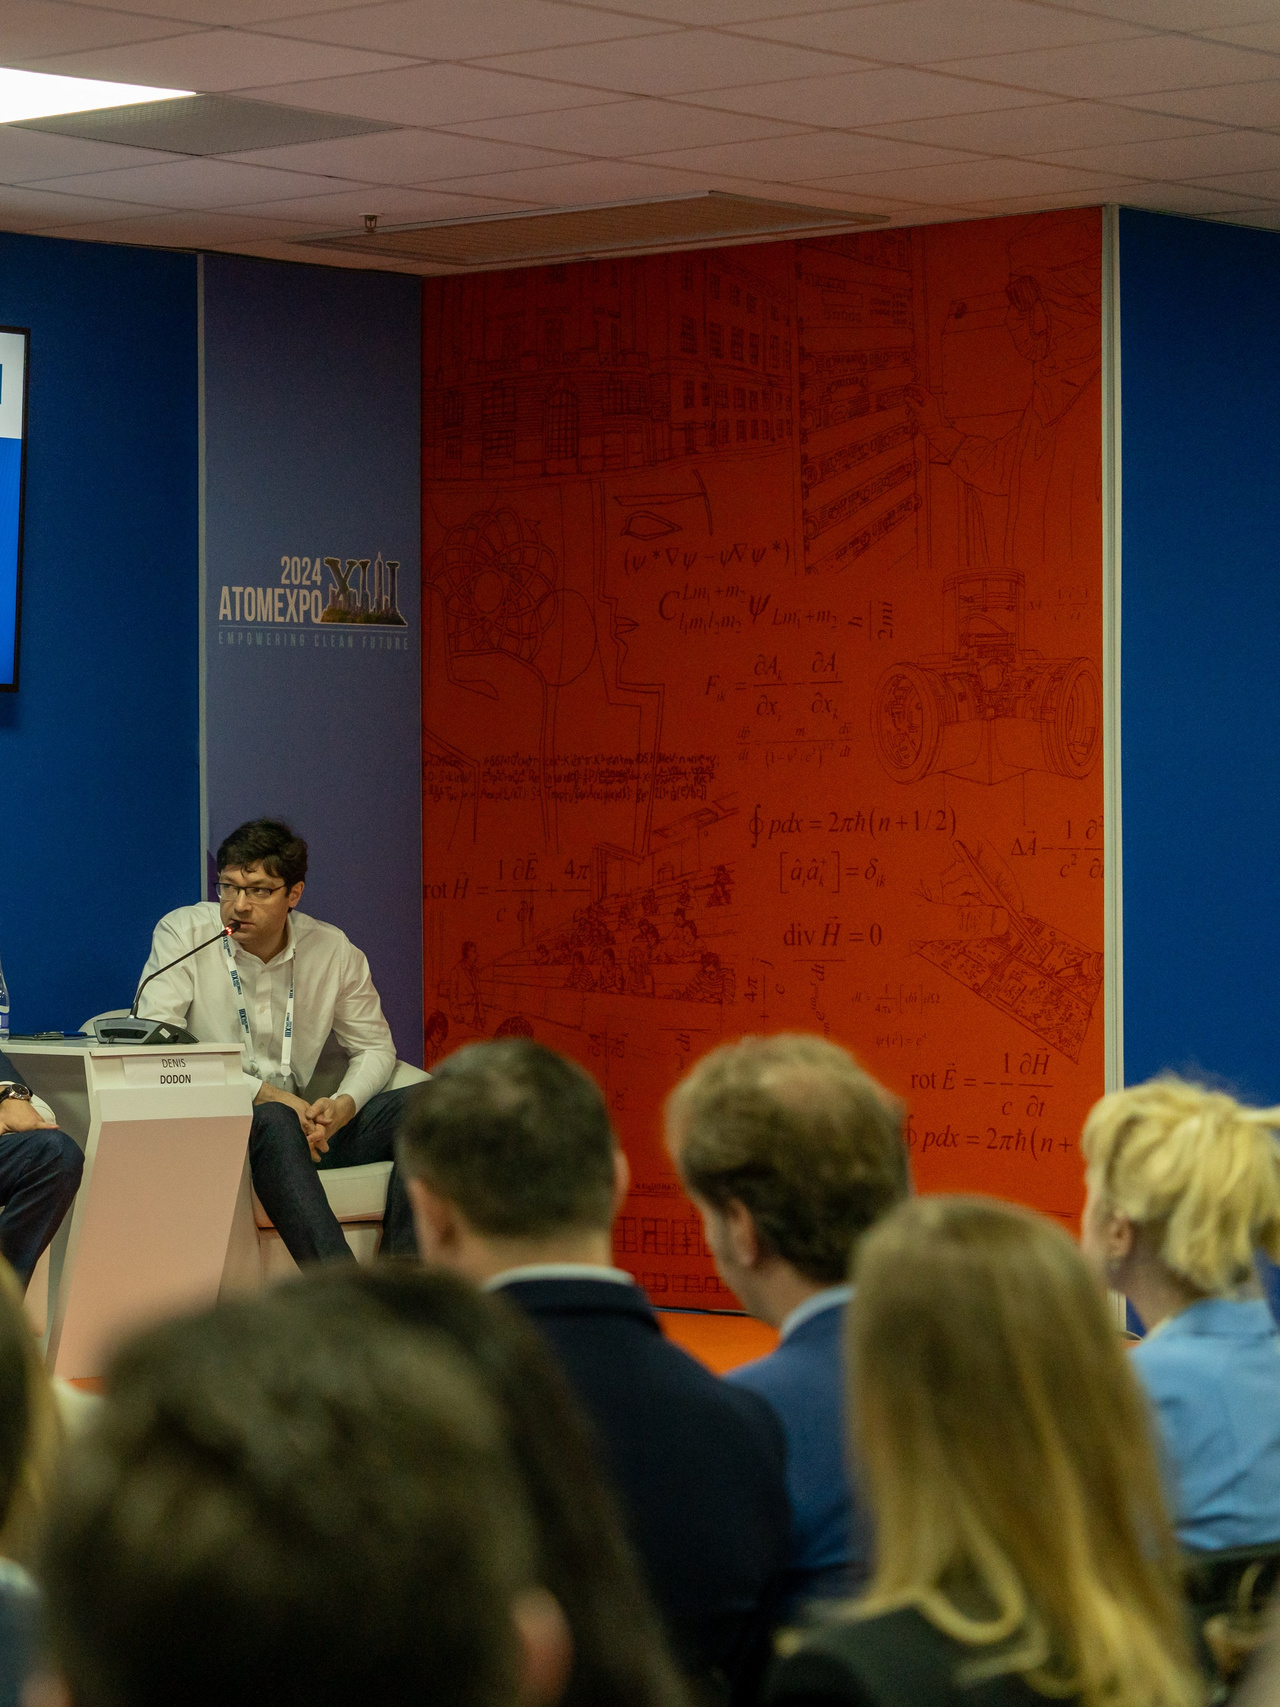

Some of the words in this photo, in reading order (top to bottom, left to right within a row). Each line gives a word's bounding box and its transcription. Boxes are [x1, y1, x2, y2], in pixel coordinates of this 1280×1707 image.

[281, 556, 322, 586] 2024
[219, 586, 322, 623] ATOMEXPO
[219, 632, 305, 647] EMPOWERING
[314, 635, 354, 648] CLEAN
[362, 637, 408, 650] FUTURE
[783, 923, 815, 947] div
[161, 1058, 186, 1068] DENIS
[160, 1074, 192, 1085] DODON
[911, 1072, 936, 1089] rot
